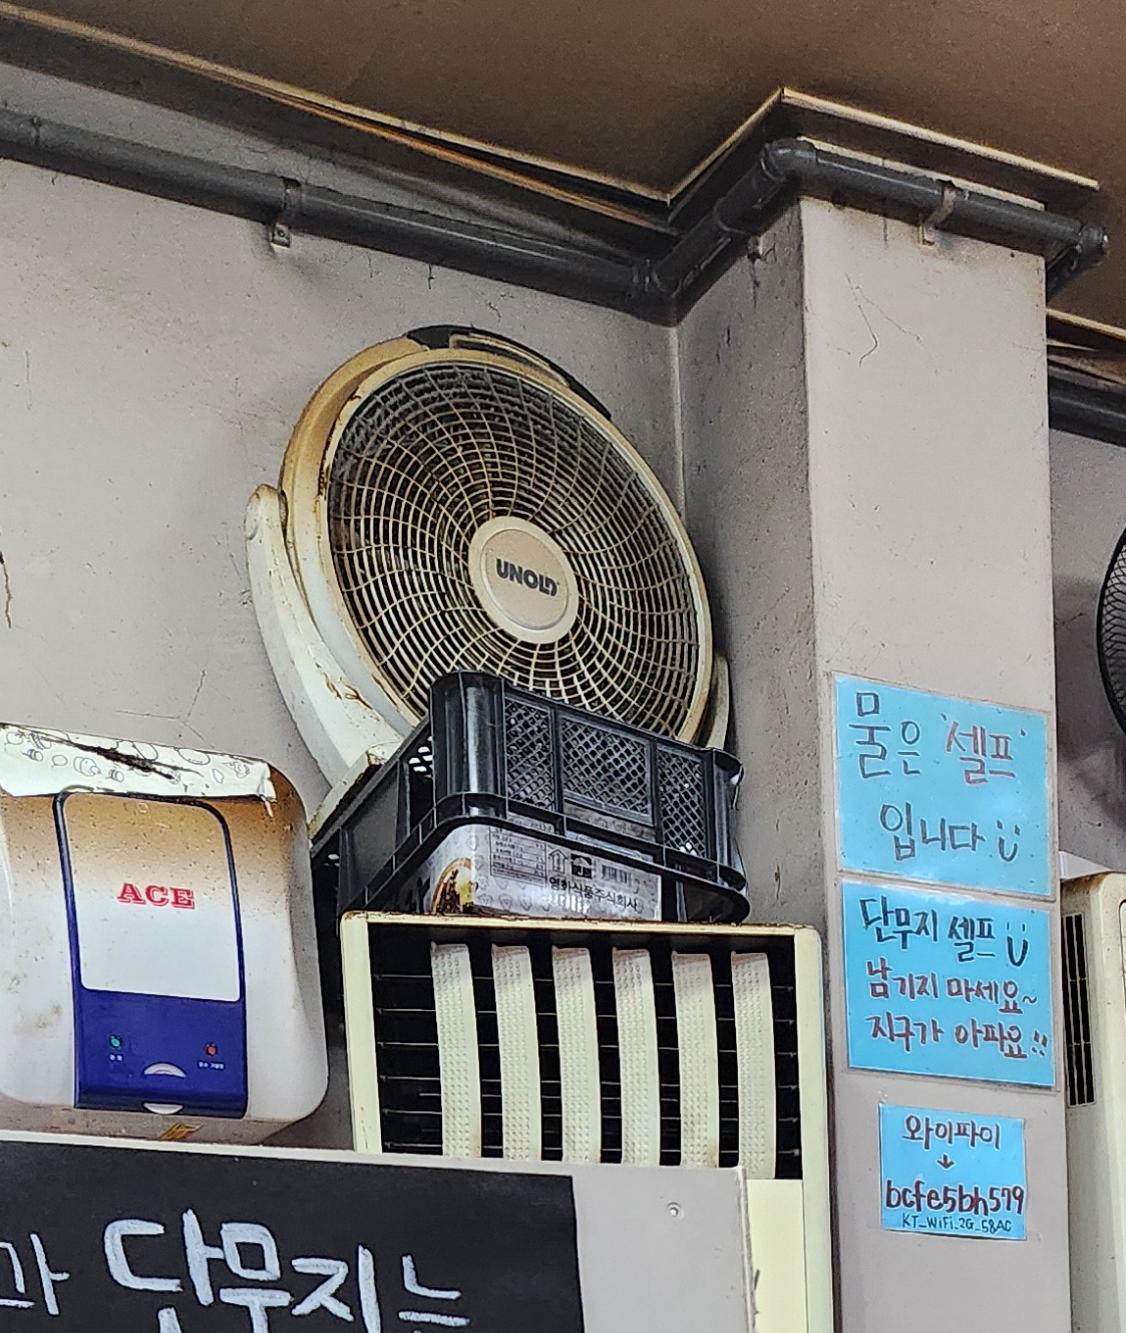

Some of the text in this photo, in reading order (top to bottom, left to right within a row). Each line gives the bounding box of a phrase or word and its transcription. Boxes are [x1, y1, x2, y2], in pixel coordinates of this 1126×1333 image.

[496, 557, 560, 598] UNOLD
[849, 692, 921, 779] 물은
[880, 802, 985, 861] 입니다
[118, 882, 196, 910] ACE
[859, 896, 996, 962] 단무지 셀프
[867, 957, 939, 1000] 남기지
[865, 1011, 945, 1052] 지구가
[902, 1115, 1001, 1150] 와이파이
